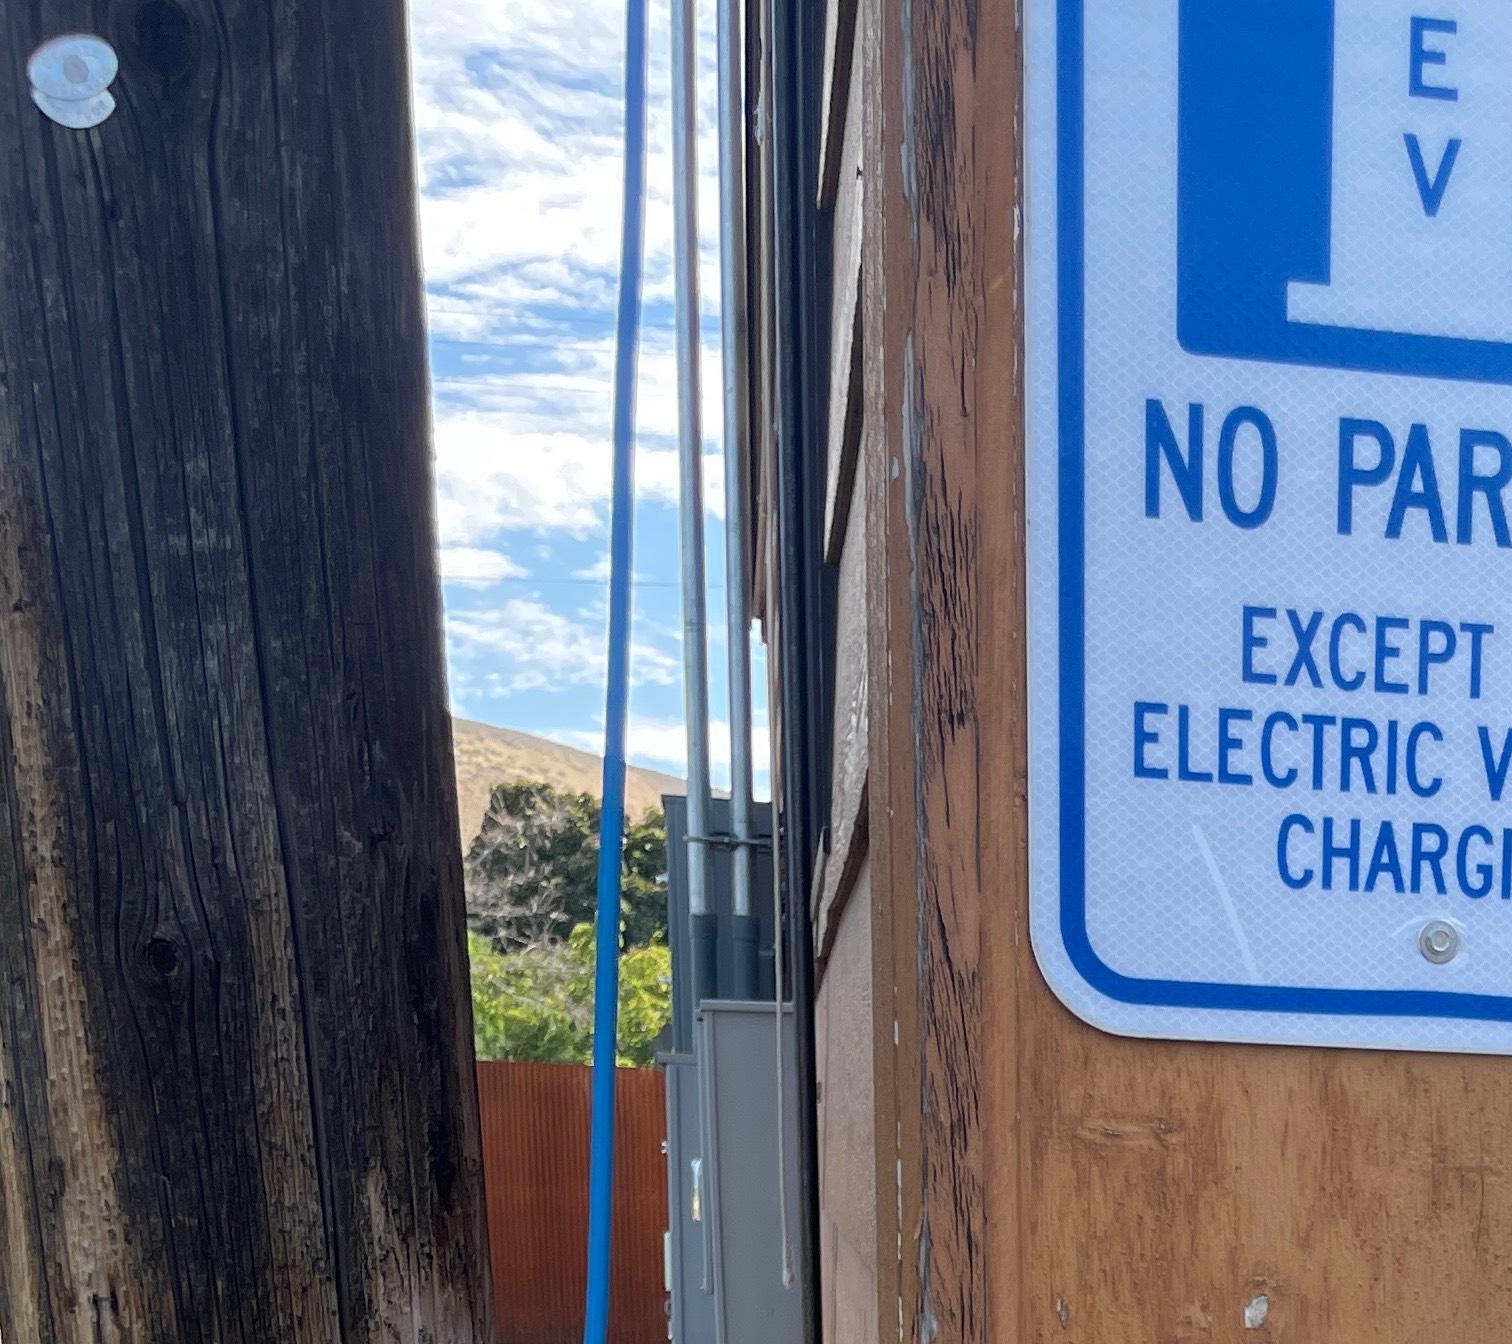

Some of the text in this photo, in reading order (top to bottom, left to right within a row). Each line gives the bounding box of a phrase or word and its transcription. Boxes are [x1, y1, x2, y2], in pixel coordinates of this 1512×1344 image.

[1144, 398, 1279, 529] NO
[1241, 606, 1494, 700] EXCEPT
[1132, 700, 1445, 799] ELECTRIC
